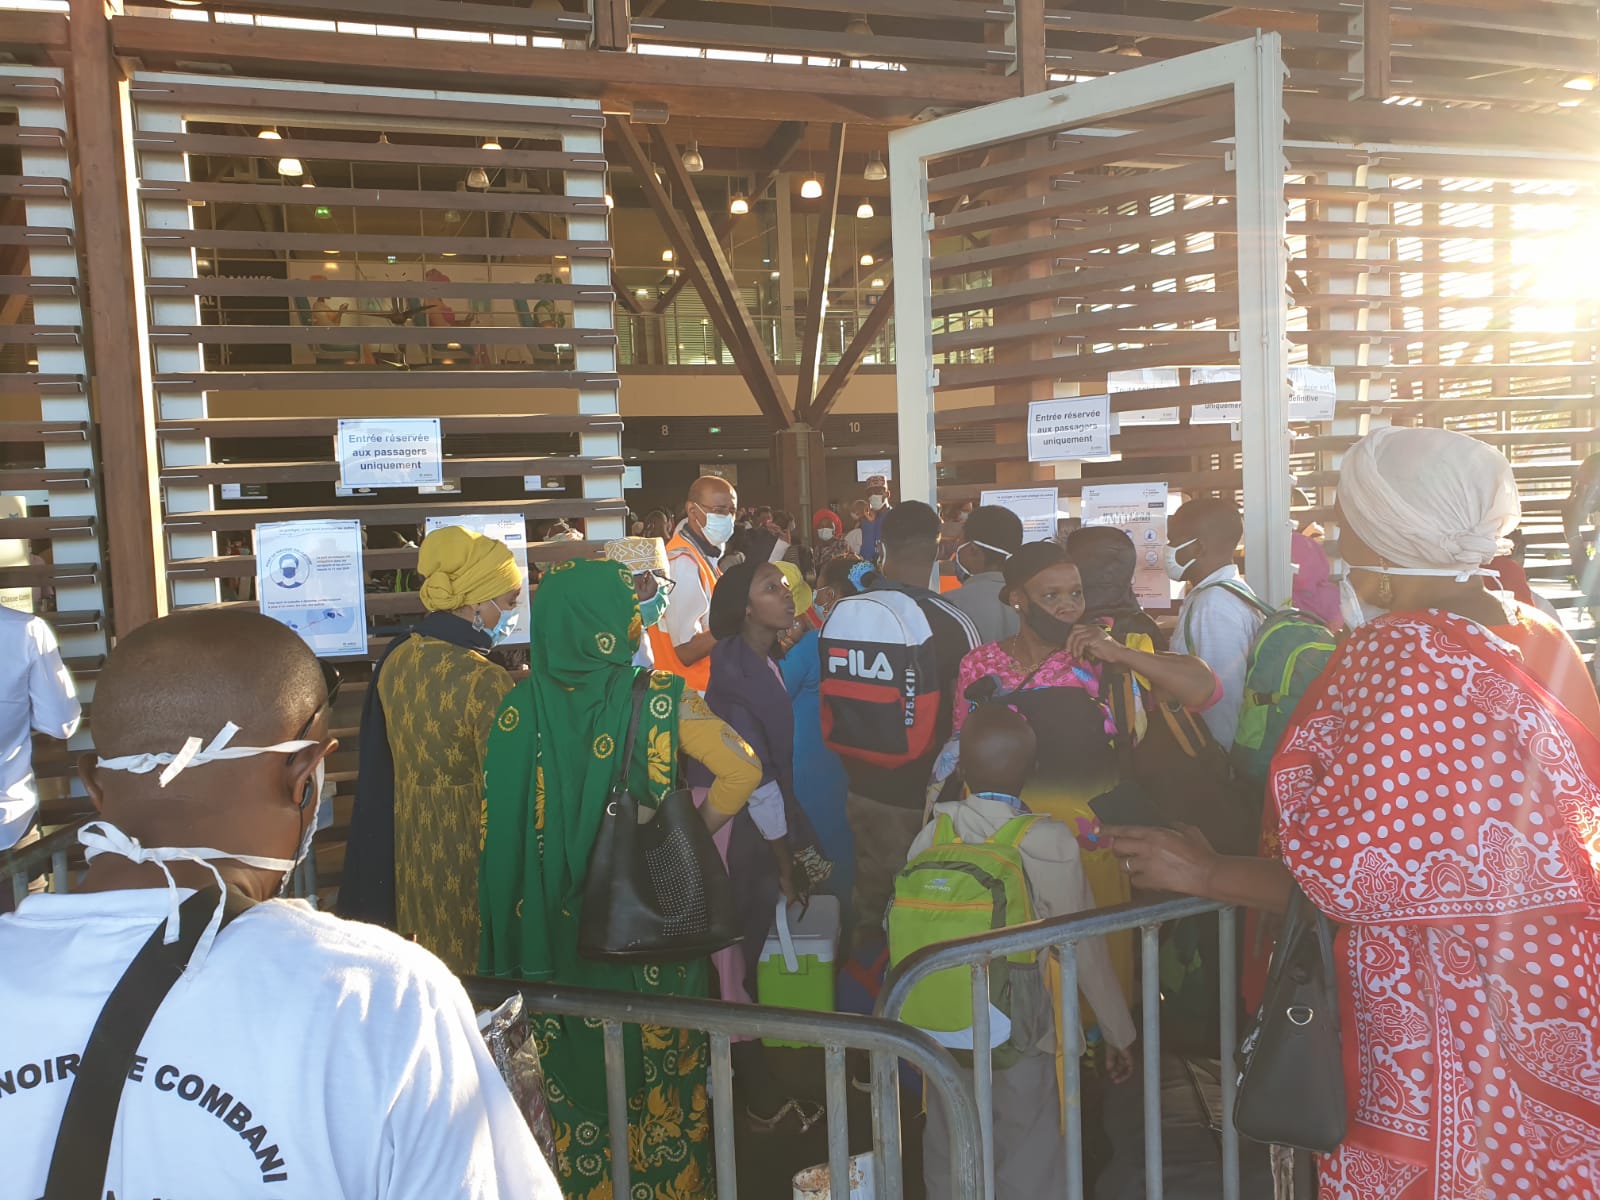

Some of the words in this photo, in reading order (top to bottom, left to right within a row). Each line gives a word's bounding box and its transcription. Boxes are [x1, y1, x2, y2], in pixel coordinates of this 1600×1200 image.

[1035, 412, 1062, 422] Entrée
[1064, 409, 1101, 420] réservée
[661, 424, 669, 436] 8
[849, 421, 860, 433] 10
[1037, 426, 1052, 434] aux
[1054, 423, 1098, 433] passagers
[348, 433, 383, 443] Entrée
[385, 433, 430, 442] réservée
[1043, 435, 1093, 446] uniquement
[352, 449, 371, 457] aux
[374, 448, 428, 458] passagers
[360, 461, 422, 472] uniquement
[828, 647, 894, 681] FILA
[154, 1063, 288, 1184] COMBANI
